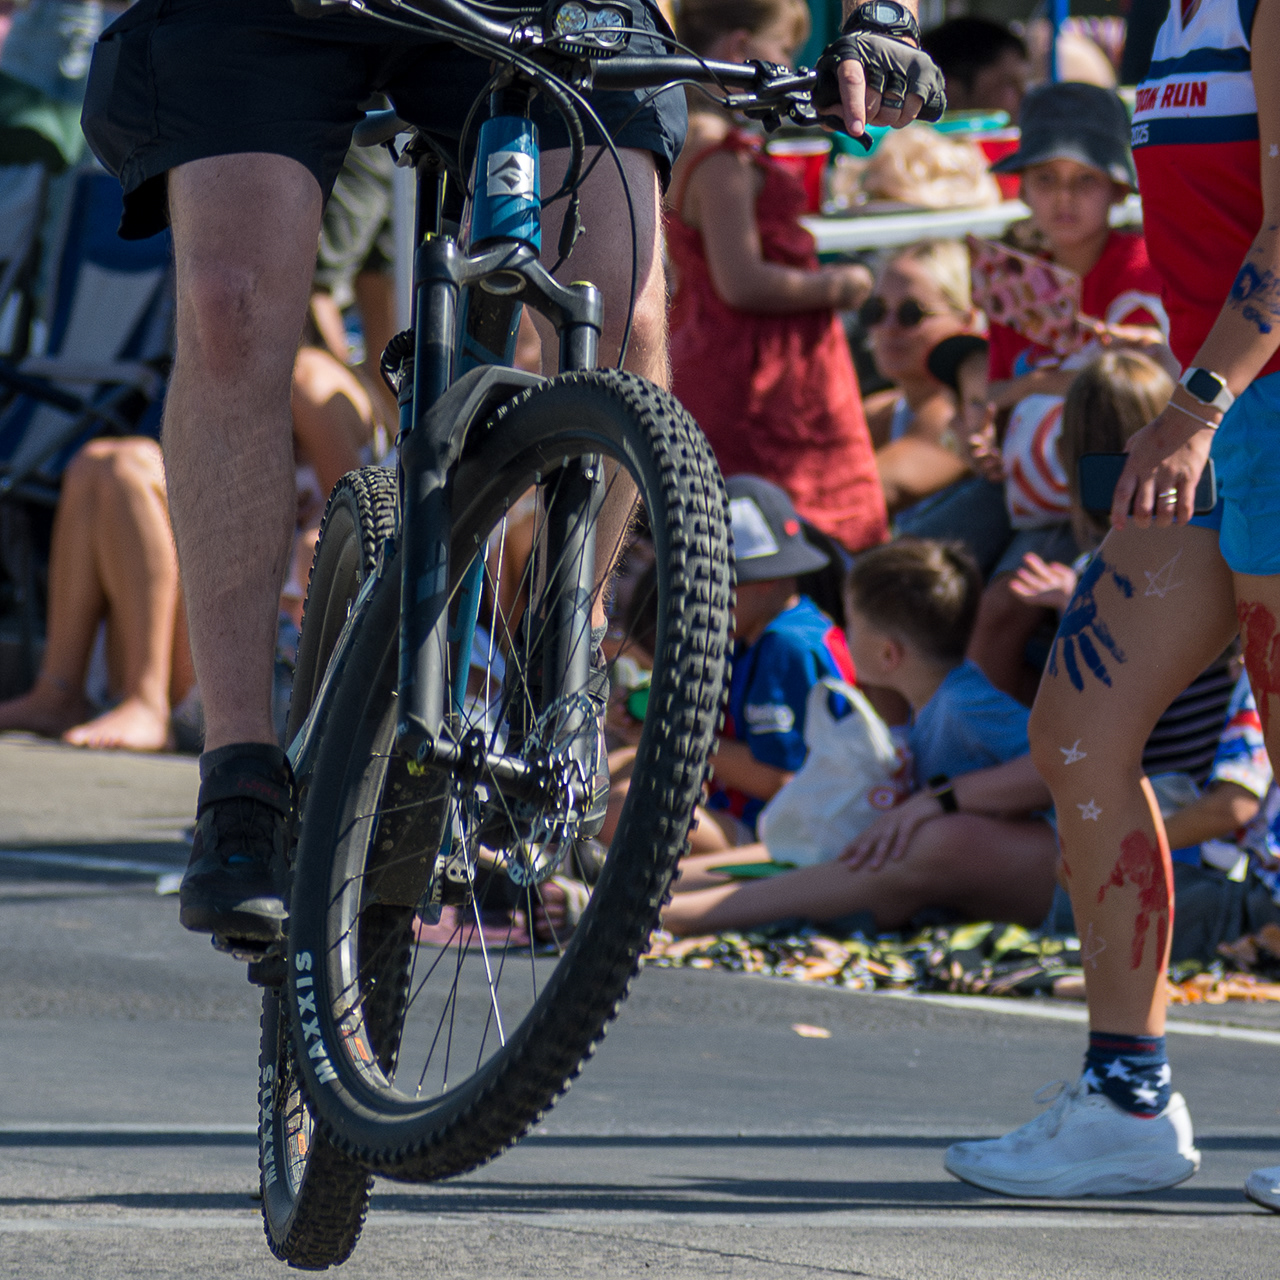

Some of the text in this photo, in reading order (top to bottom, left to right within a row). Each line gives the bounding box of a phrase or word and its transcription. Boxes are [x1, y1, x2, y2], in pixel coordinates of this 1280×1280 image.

[1161, 81, 1207, 109] RUN
[295, 951, 338, 1085] MAXXIS
[261, 1064, 278, 1189] MAXXIS
